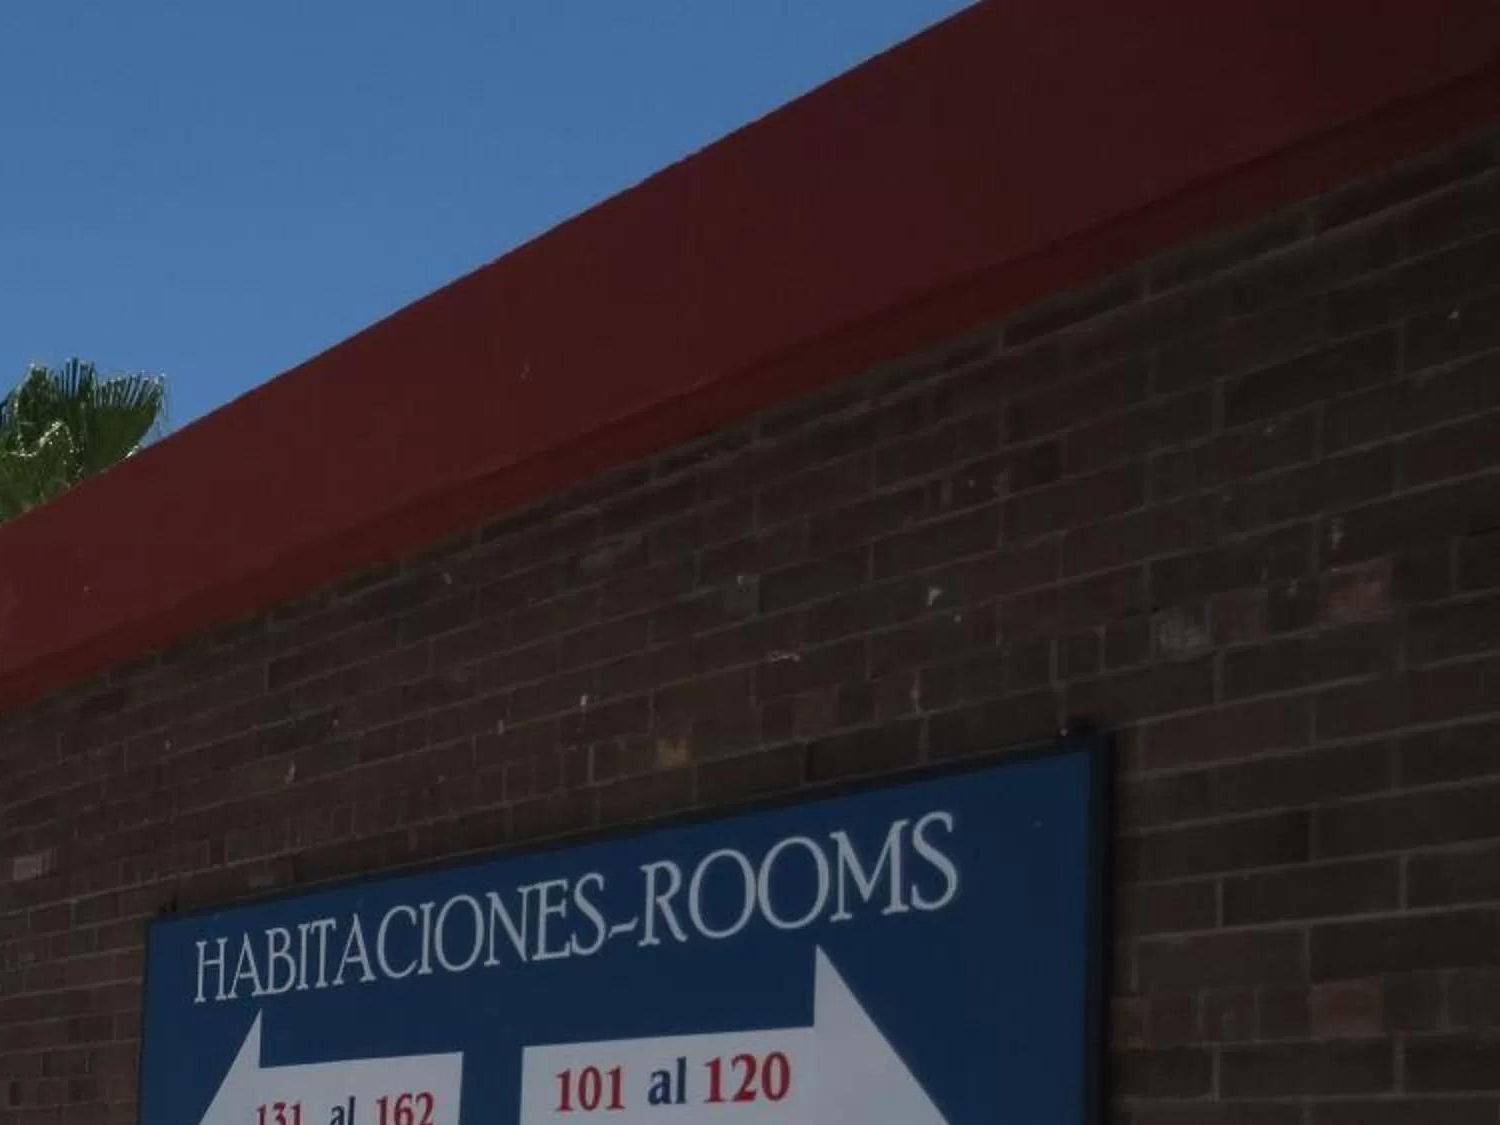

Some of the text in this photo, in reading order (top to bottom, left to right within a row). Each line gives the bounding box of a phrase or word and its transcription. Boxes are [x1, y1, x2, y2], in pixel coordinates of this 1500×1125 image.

[194, 811, 959, 1003] HABITACIONES-ROOMS
[556, 1051, 791, 1112] 101 al 120
